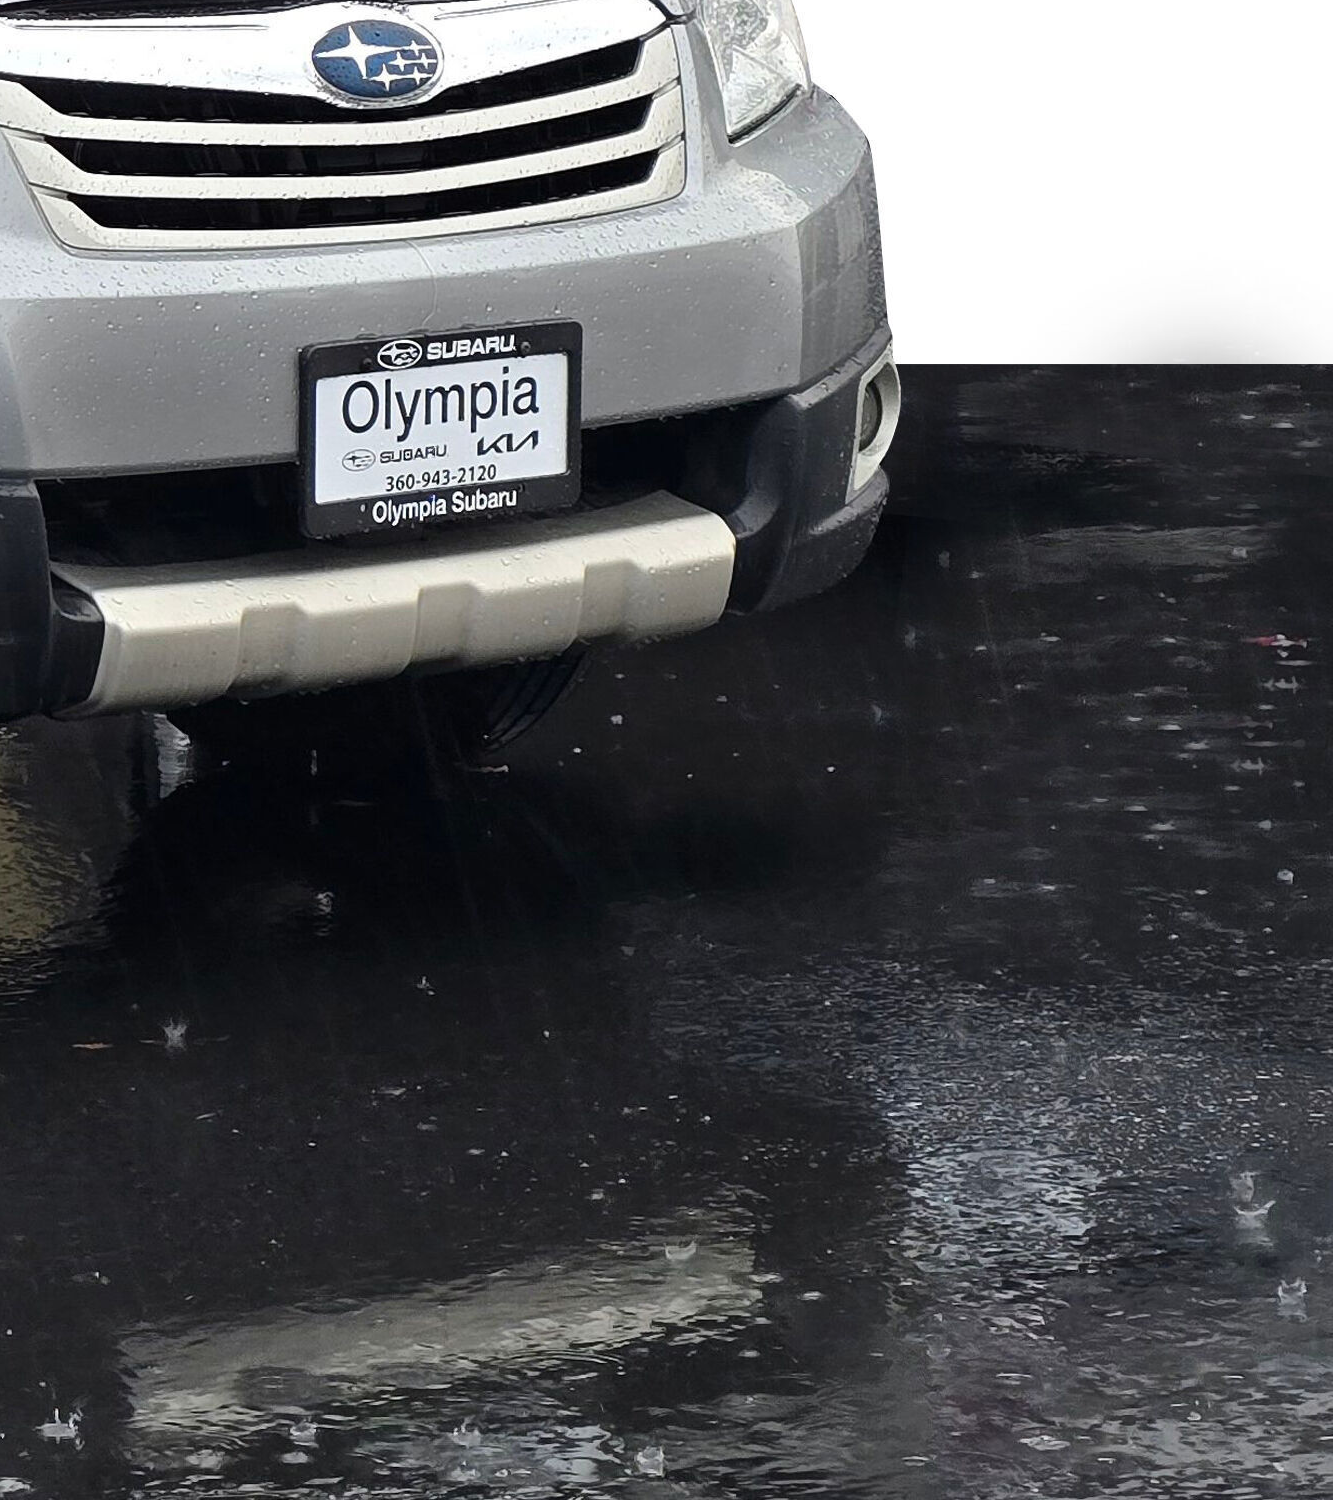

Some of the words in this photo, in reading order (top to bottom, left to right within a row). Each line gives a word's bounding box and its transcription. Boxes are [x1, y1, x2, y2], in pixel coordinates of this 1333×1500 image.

[342, 366, 540, 442] Olympia
[379, 444, 448, 464] SUBARU
[385, 464, 497, 492] 360-943-2120
[372, 493, 447, 527] Olympia
[451, 488, 518, 514] Subaru
